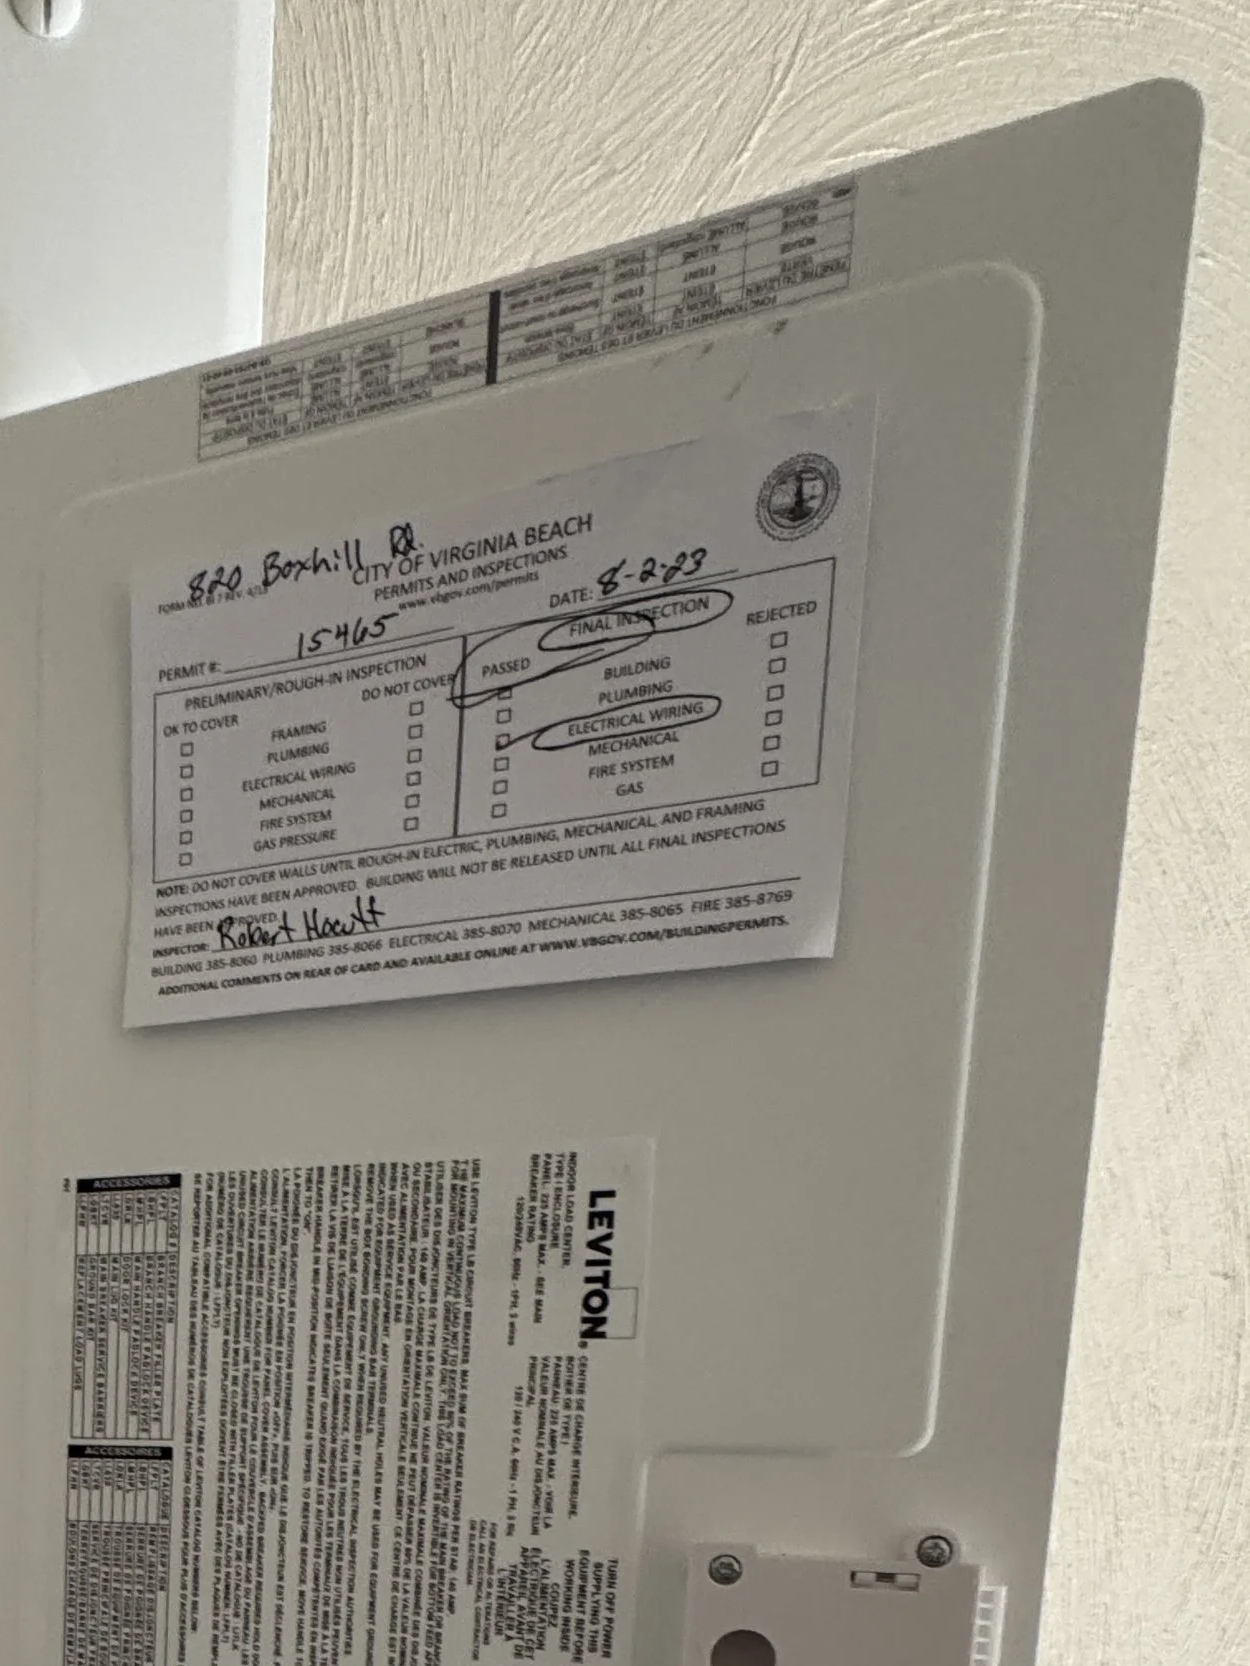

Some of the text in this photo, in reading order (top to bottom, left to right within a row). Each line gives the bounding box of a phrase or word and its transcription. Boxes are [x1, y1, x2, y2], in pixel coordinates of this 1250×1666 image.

[352, 513, 594, 586] CITY OF VIRGINIA BEACH
[187, 564, 243, 601] 820
[261, 538, 366, 588] Boxhill
[373, 544, 568, 601] PERMITS AND INSPECTIONS
[549, 587, 594, 609] DATE:
[569, 597, 710, 637] FINAL INSPECTION
[746, 601, 818, 626] REJECTED
[298, 612, 400, 660] 15465
[158, 664, 204, 683] PERMIT
[481, 657, 531, 678] PASSED
[603, 656, 671, 681] BUILDING
[184, 654, 427, 711] PRELIMINARY/ROUGH-IN INSPECTION
[361, 672, 457, 702] DO NOT COVER
[598, 680, 673, 705] PLUMBING
[163, 714, 239, 738] OK TO COVER
[567, 701, 704, 736] ELECTRICAL WIRING
[271, 721, 327, 743] FRAMING
[588, 730, 680, 756] MECHANICAL
[266, 742, 330, 764] PLUMBING
[241, 762, 356, 793] ELECTRICAL WIRING
[588, 754, 675, 780] FIRE SYSTEM
[259, 788, 336, 811] MECHANICAL
[615, 782, 645, 798] GAS
[259, 809, 332, 832] FIRE SYSTEM
[253, 829, 338, 853] GAS PRESSURE
[216, 910, 298, 950] Robert
[579, 1188, 616, 1340] LEVITON
[602, 1558, 619, 1659] TURN OFF POWER
